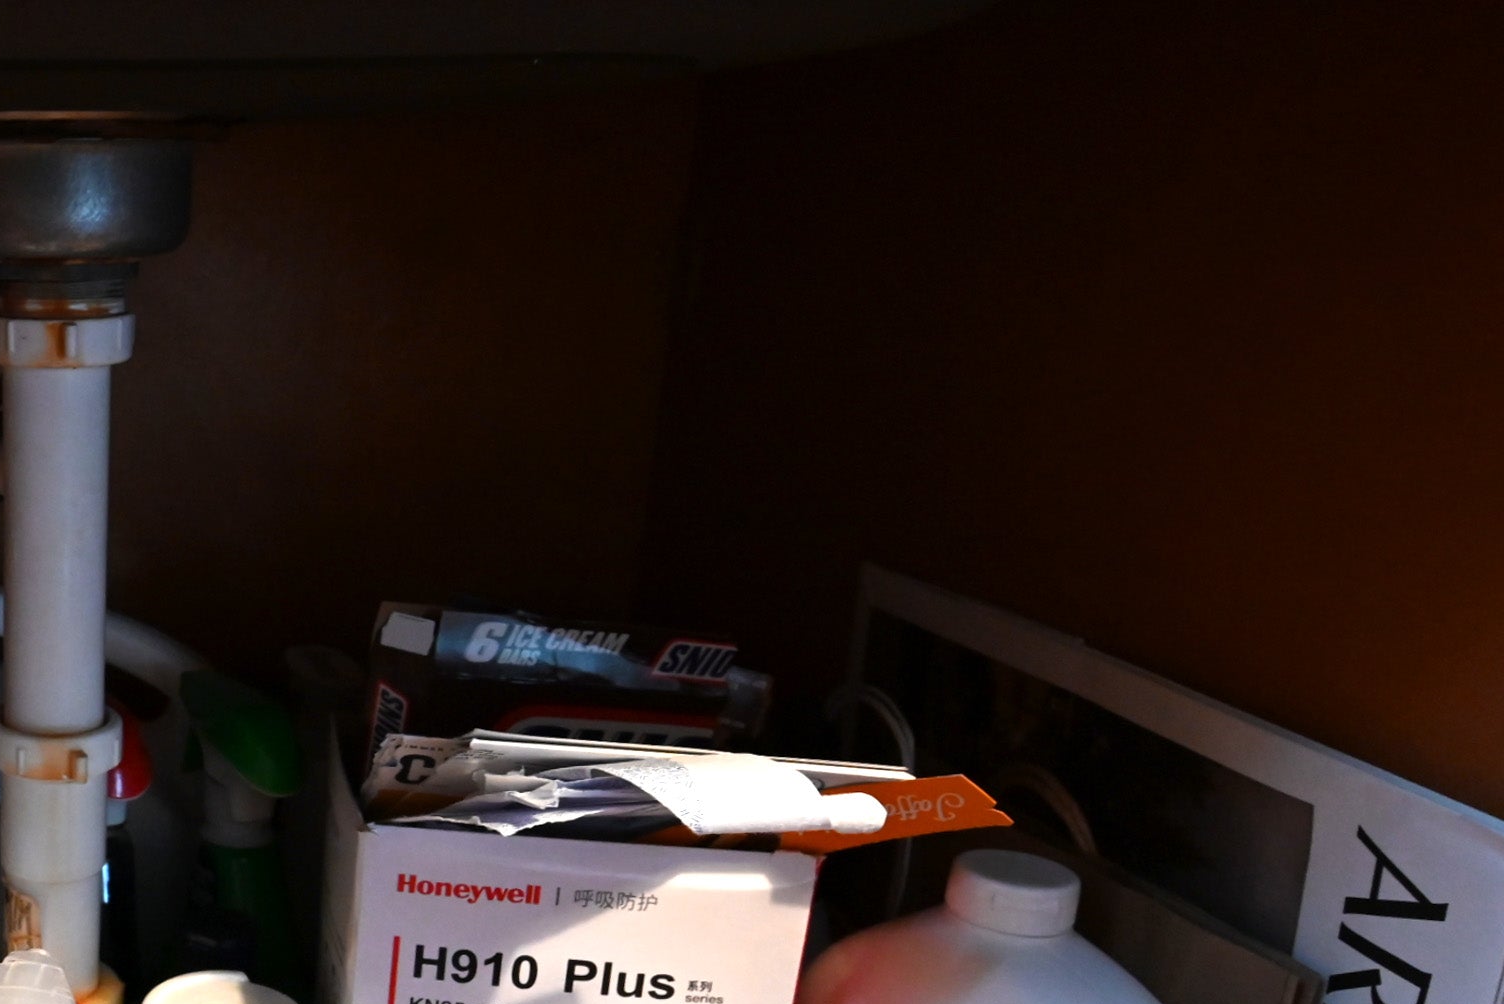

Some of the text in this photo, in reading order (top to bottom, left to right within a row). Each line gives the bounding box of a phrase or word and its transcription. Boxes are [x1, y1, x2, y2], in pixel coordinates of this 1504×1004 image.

[463, 621, 630, 663] 6 ICE CREAM
[497, 647, 542, 667] BARS
[396, 873, 542, 905] Honeywell
[573, 888, 659, 912] 呼吸防护
[413, 943, 676, 1000] H910 Plus
[687, 979, 714, 993] 系列
[685, 994, 724, 1004] series
